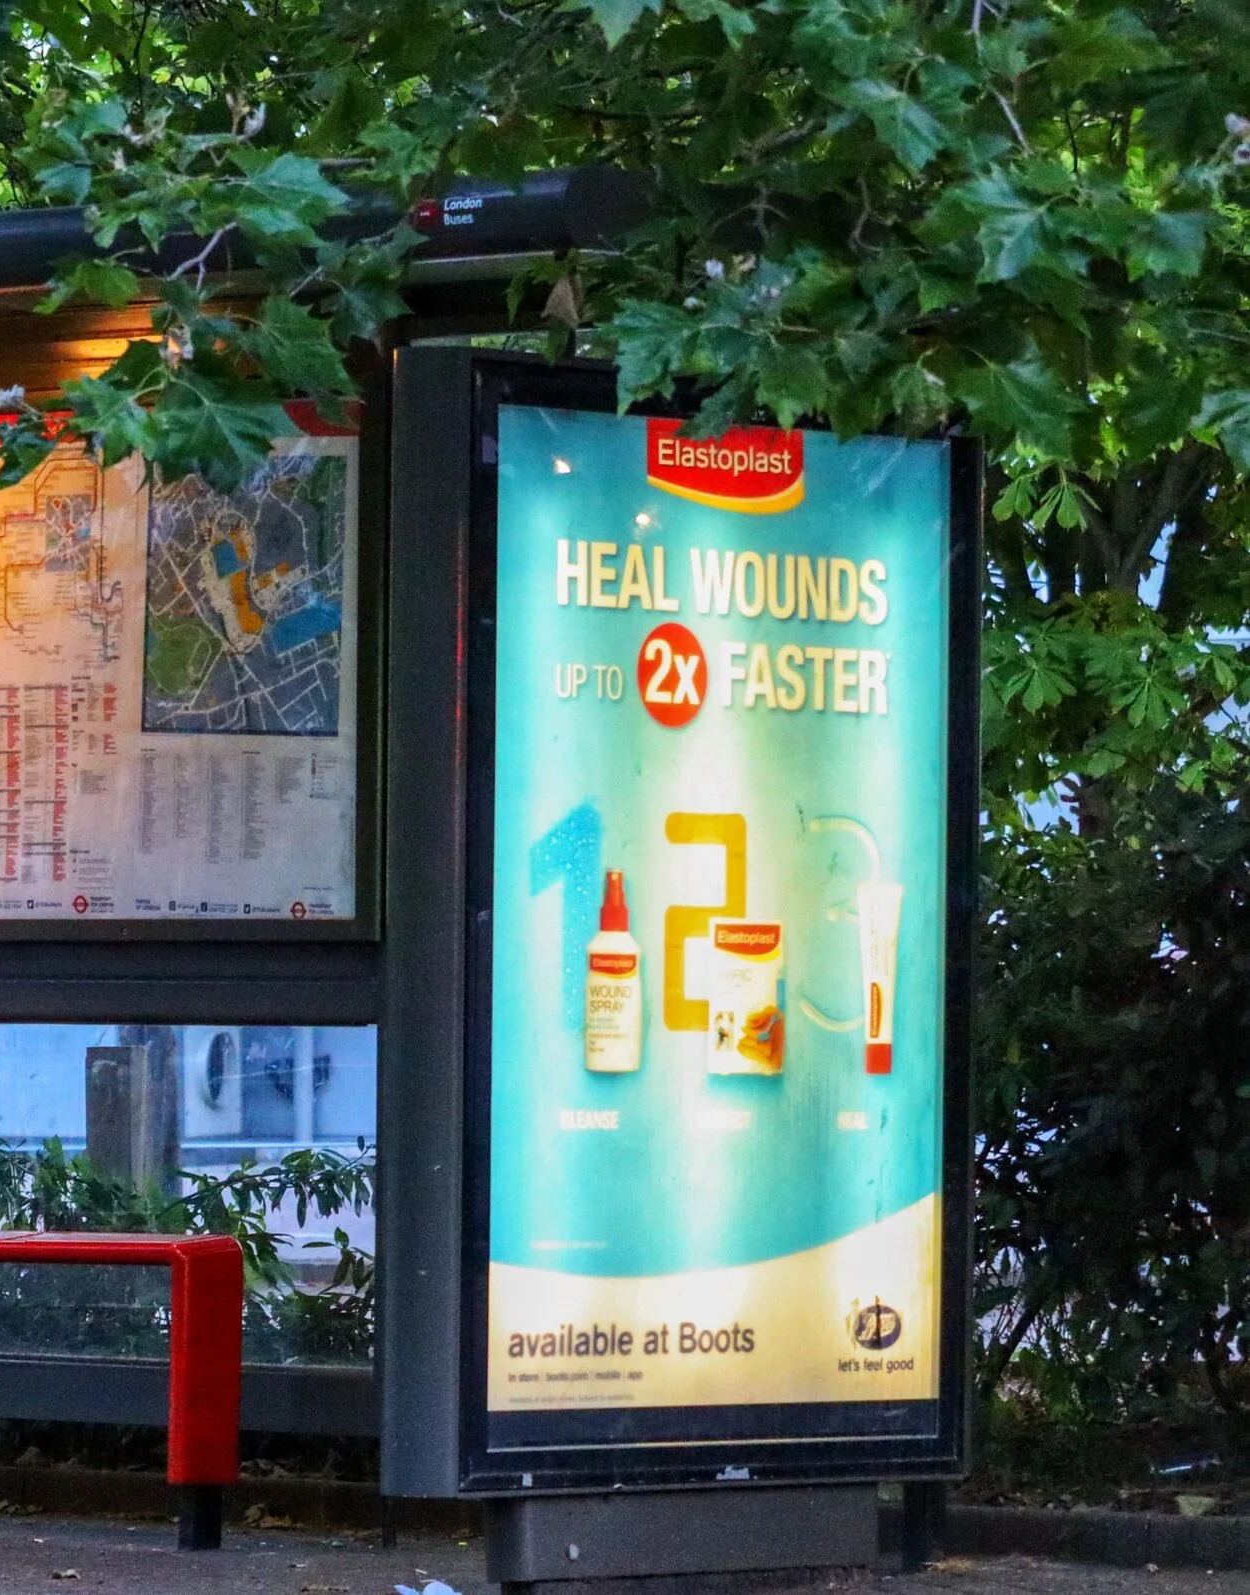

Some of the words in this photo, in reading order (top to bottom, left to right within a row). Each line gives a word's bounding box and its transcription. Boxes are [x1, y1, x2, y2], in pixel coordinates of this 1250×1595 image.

[444, 198, 483, 211] London
[444, 214, 474, 226] Buses
[657, 438, 792, 477] Elastoplast
[556, 539, 680, 612] HEAL
[690, 548, 888, 626] WOUNDS
[554, 663, 587, 699] UP
[593, 665, 624, 701] TO
[530, 803, 603, 1033] 1
[664, 812, 747, 1032] 2
[716, 929, 776, 946] Elastoplast
[589, 984, 632, 999] WOUND
[589, 999, 625, 1014] SPRAY
[559, 1110, 620, 1131] CLEANSE
[508, 1323, 634, 1358] available
[643, 1326, 669, 1355] at
[679, 1321, 755, 1355] Boots
[838, 1358, 860, 1372] let's
[863, 1357, 883, 1372] feel
[886, 1357, 915, 1375] good
